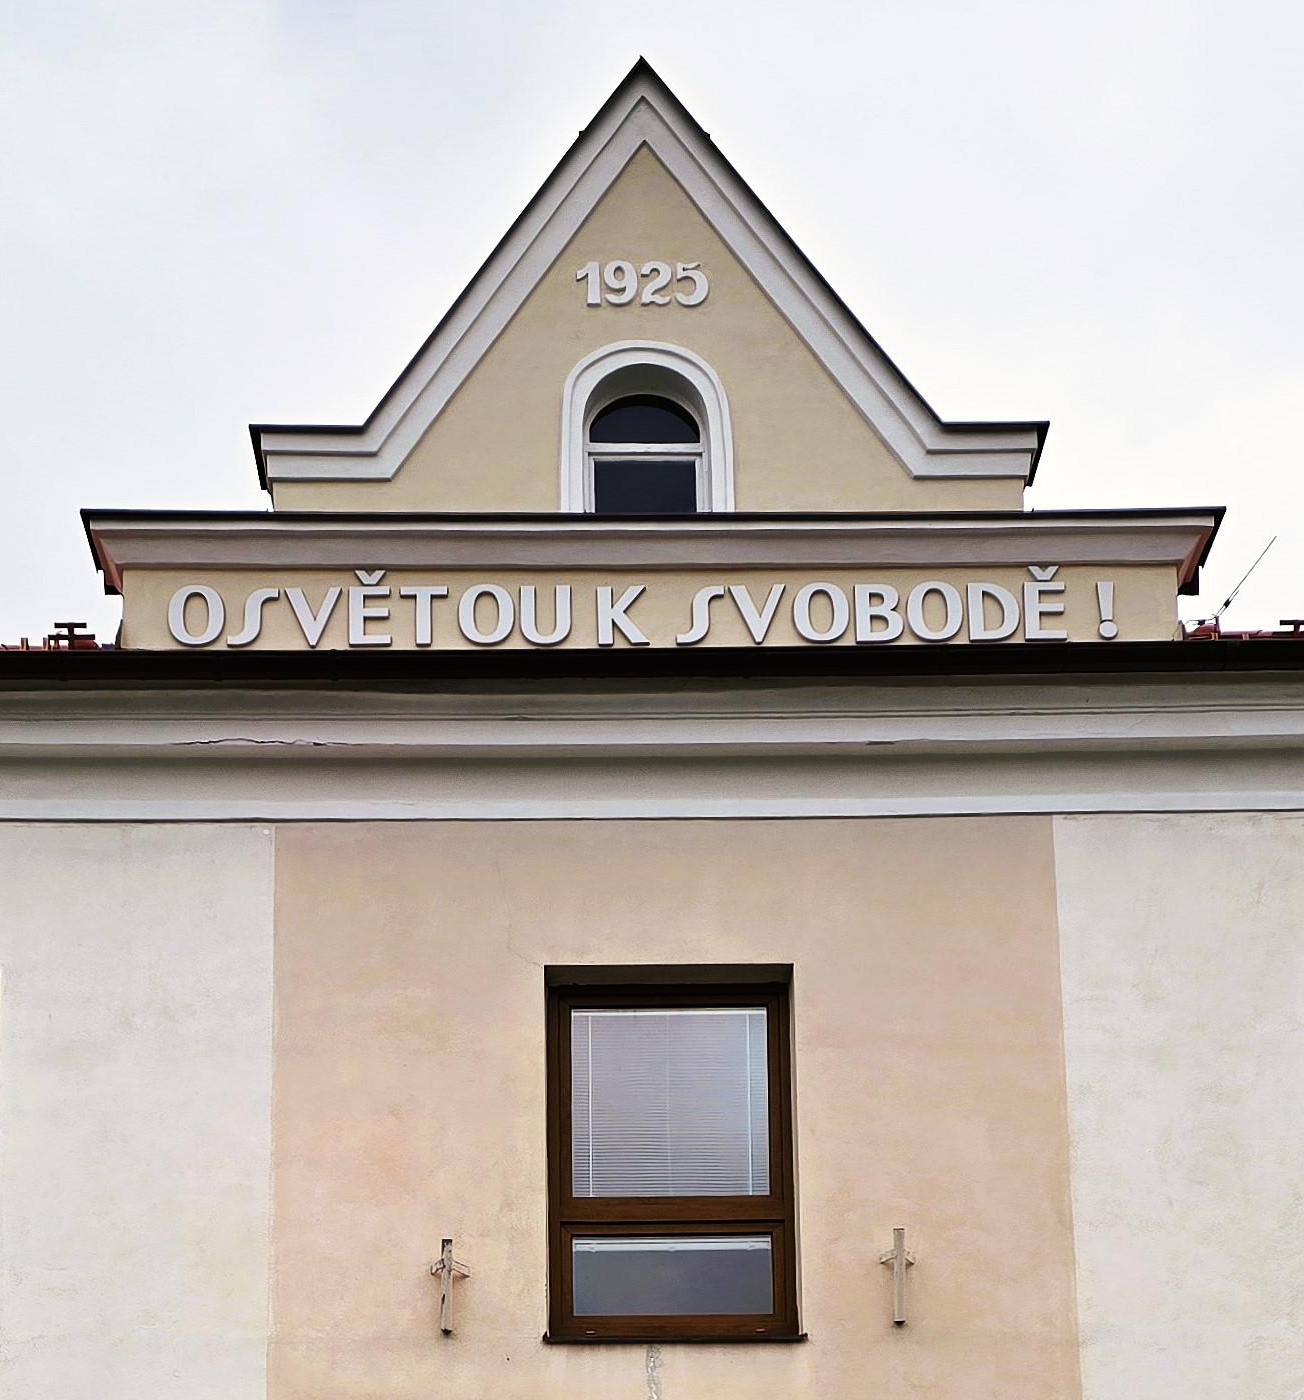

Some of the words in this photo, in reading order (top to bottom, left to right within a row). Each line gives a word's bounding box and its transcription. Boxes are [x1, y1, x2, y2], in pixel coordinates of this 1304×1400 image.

[576, 260, 709, 307] 1925
[596, 584, 651, 647] K
[676, 565, 1068, 645] SVOBODĚ
